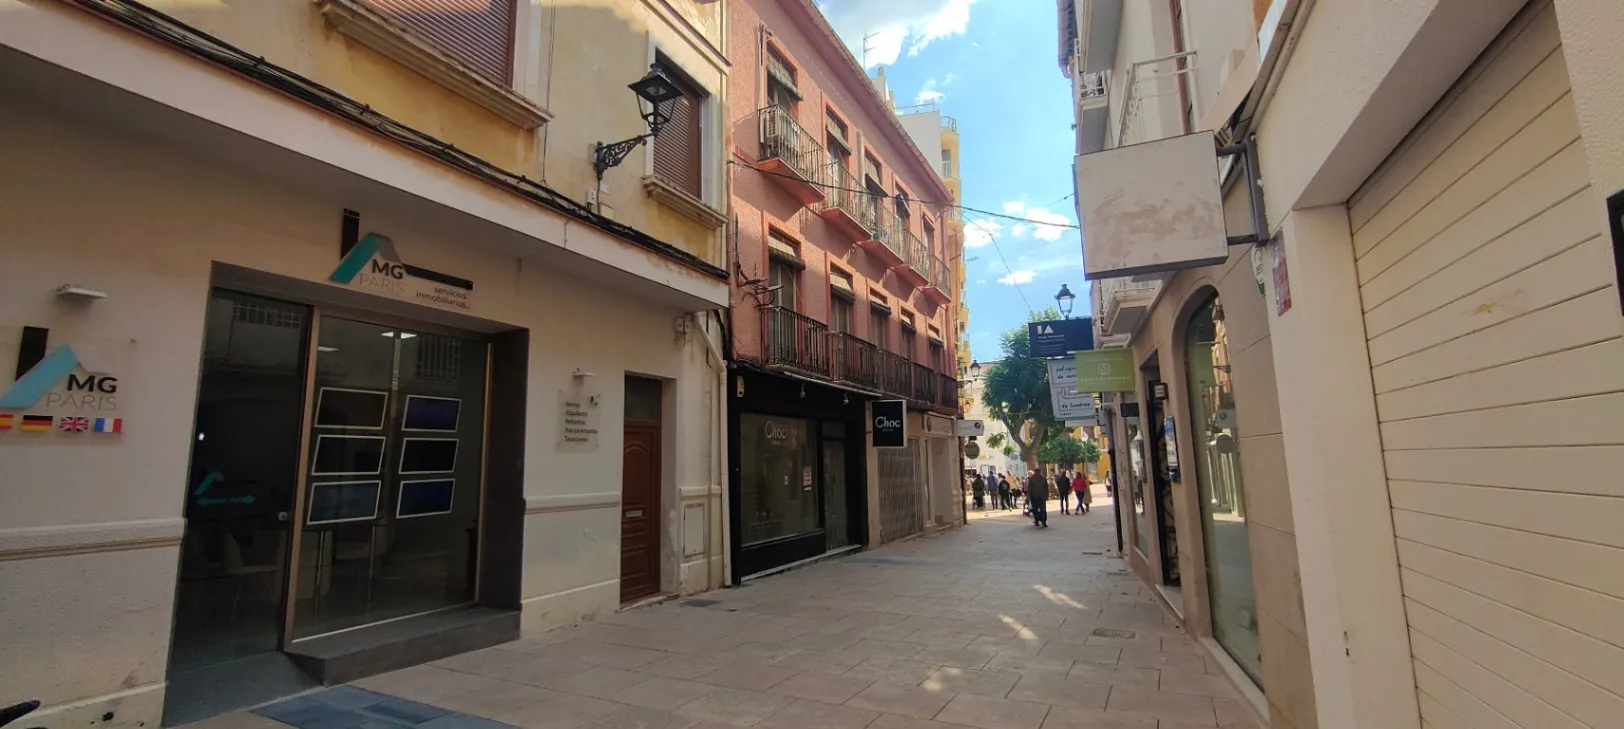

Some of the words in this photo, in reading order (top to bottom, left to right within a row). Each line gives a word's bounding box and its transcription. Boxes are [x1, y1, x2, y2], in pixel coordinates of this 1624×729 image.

[371, 258, 404, 280] MG
[359, 271, 405, 294] PARIS
[433, 286, 467, 299] servicios
[67, 373, 118, 394] MG
[45, 392, 118, 411] PARIS
[764, 420, 788, 439] Choc
[875, 416, 901, 428] Choc
